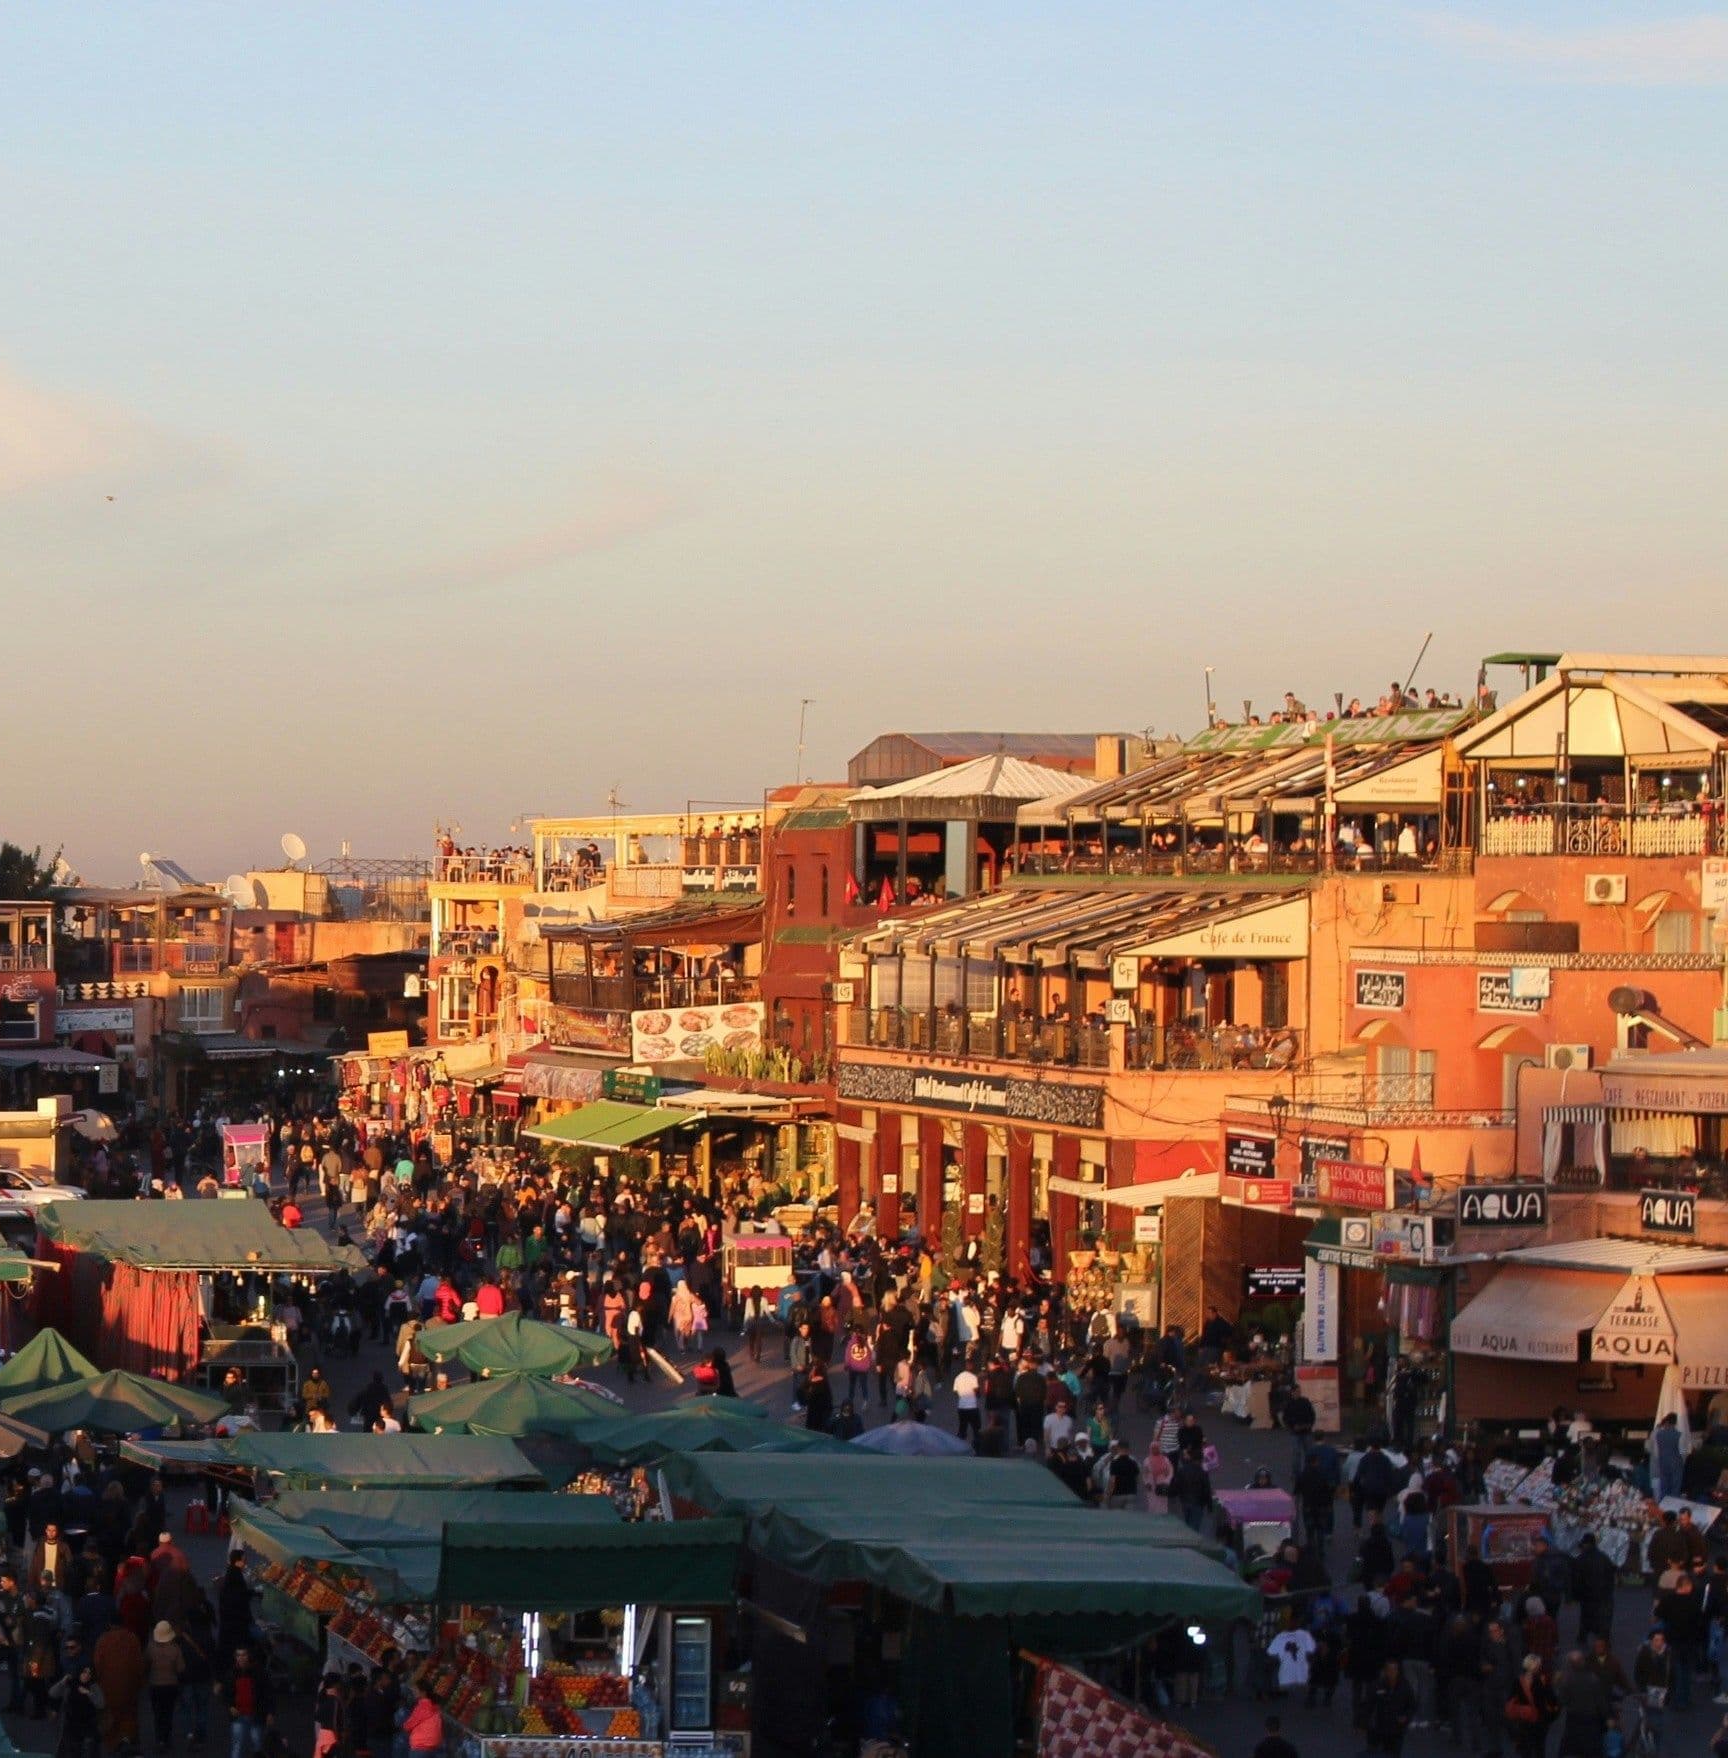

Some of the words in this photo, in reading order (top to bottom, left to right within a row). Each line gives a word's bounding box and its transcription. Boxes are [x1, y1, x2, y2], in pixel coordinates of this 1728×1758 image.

[1339, 712, 1459, 742] FRANCE
[1200, 931, 1228, 945] Café
[1232, 932, 1246, 944] de
[1250, 932, 1292, 945] France
[1343, 1166, 1366, 1187] CINQ
[1463, 1192, 1541, 1219] AQUA
[1642, 1197, 1692, 1227] AQUA
[1609, 1315, 1659, 1328] TERRASSE
[1480, 1334, 1518, 1352] AQUA
[1527, 1341, 1575, 1355] RESTAURANT
[1594, 1335, 1673, 1356] AQUA
